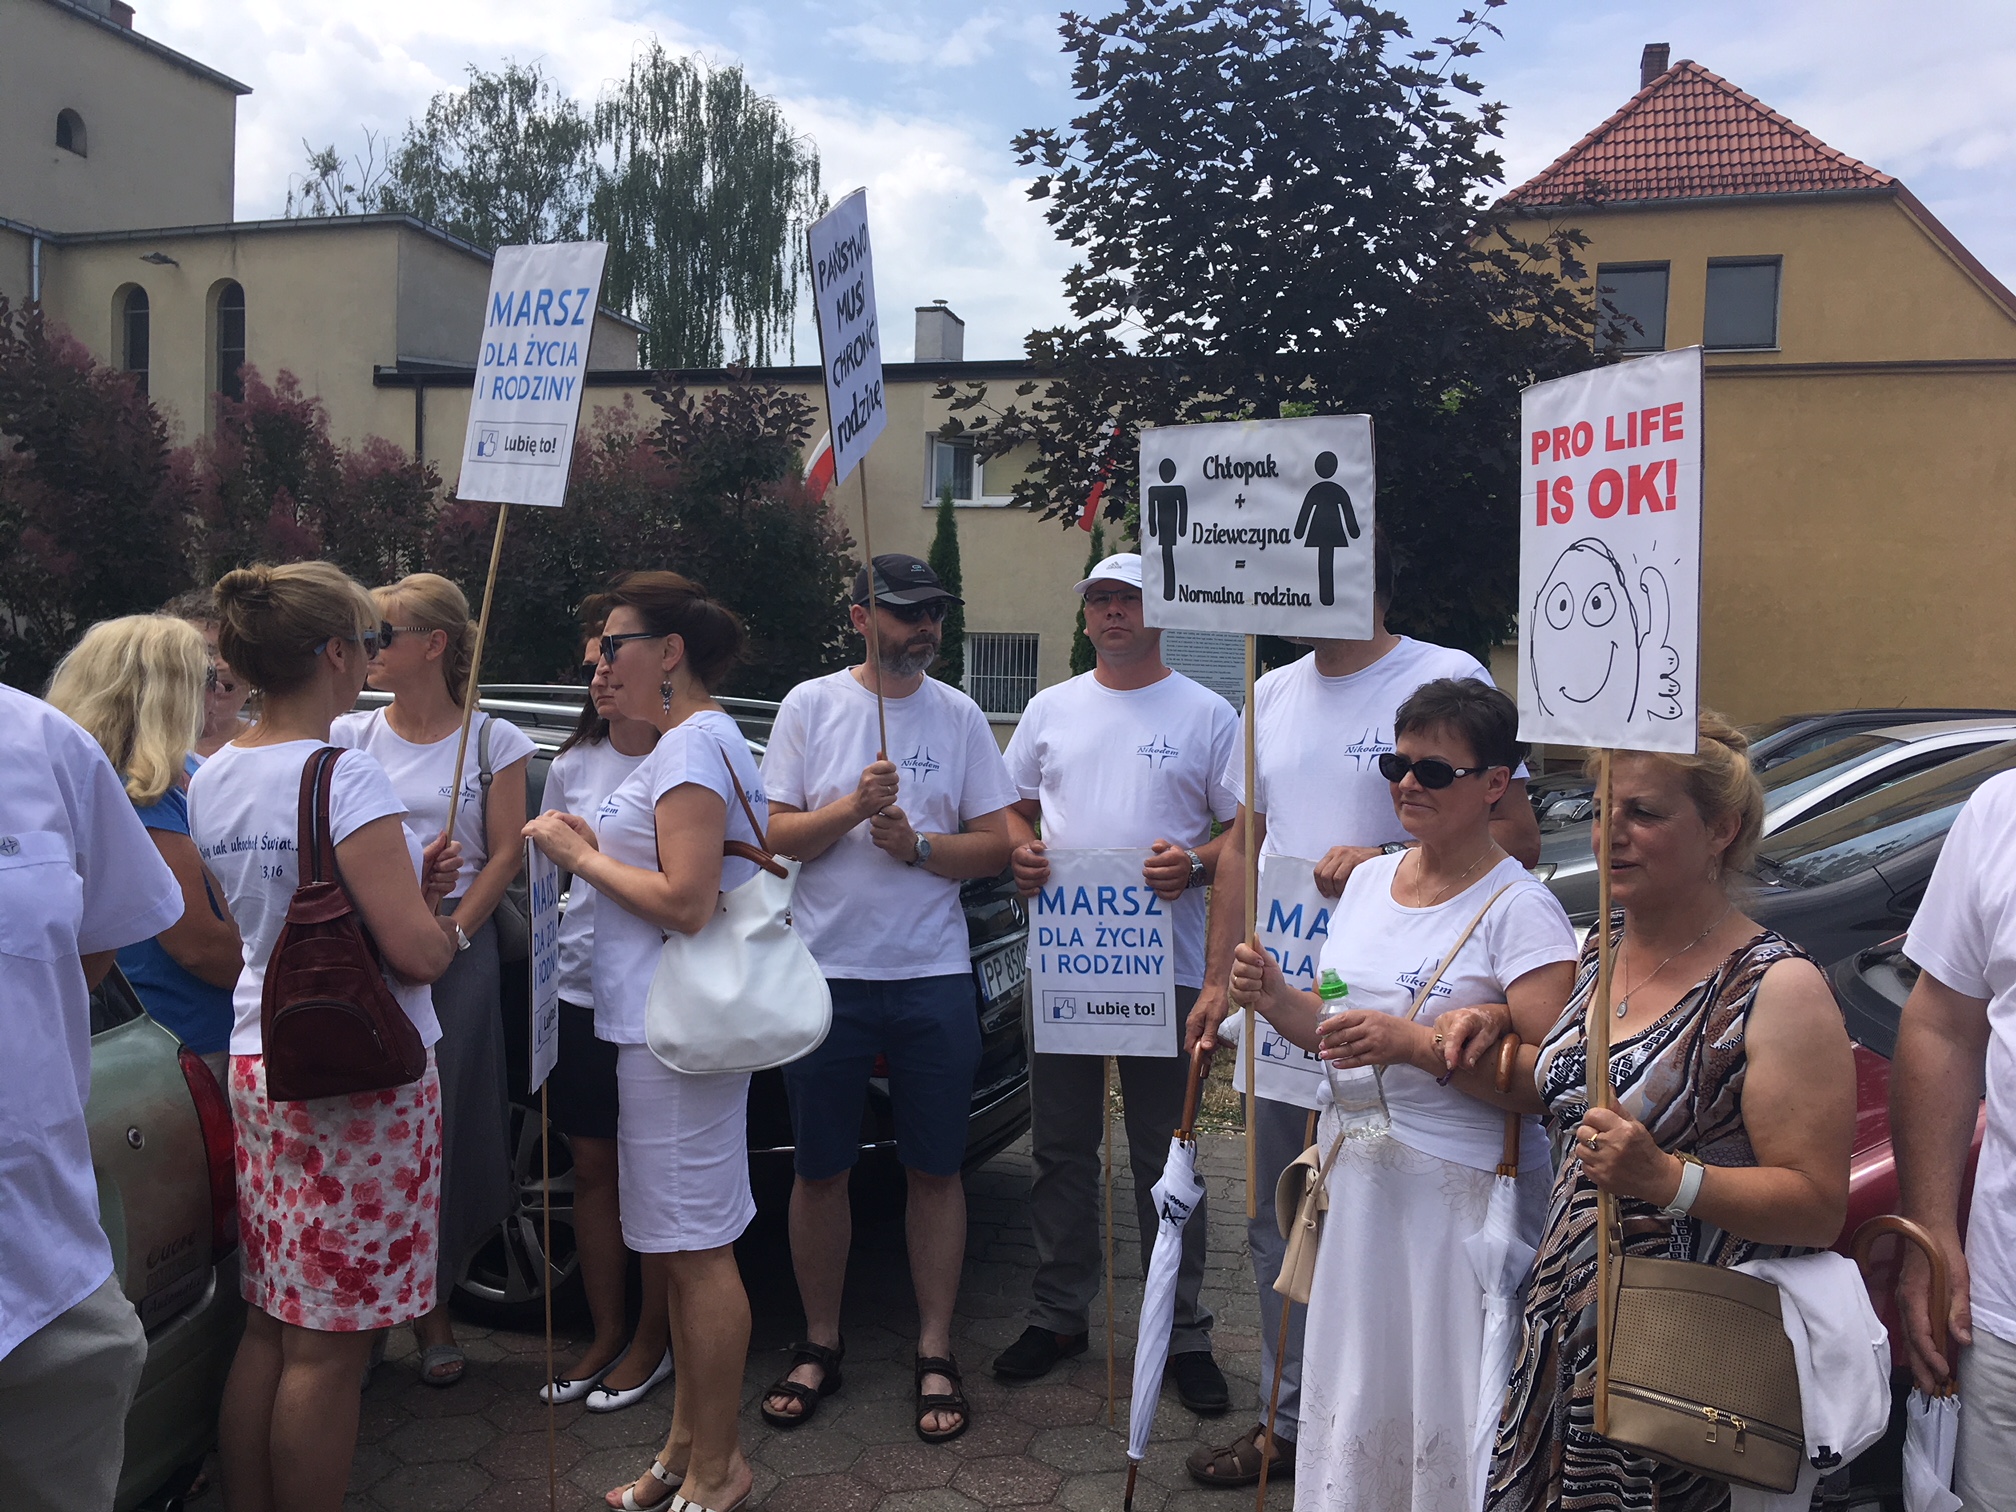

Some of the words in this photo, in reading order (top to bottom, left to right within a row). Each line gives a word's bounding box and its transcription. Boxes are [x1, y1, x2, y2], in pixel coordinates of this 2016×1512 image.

[490, 288, 590, 327] MARSZ
[484, 342, 517, 367] DLA
[524, 334, 578, 367] ŻYCIA
[479, 376, 485, 400] I
[492, 376, 576, 401] RODZINY
[504, 435, 537, 457] Lubię
[540, 437, 557, 454] to!
[1532, 421, 1594, 466] PRO
[1605, 402, 1684, 452] LIFE
[1536, 475, 1574, 527] IS
[1588, 458, 1677, 519] OK!
[1192, 522, 1292, 551] Dziewczyna
[1179, 584, 1245, 604] Normalna
[1254, 585, 1312, 607] rodzina
[1136, 747, 1179, 756] Nikodem
[1344, 745, 1393, 754] Nikodem
[901, 760, 940, 770] Nikodem
[213, 840, 227, 856] tak
[1037, 886, 1162, 916] MARSZ
[1266, 899, 1330, 940] MA
[1039, 927, 1084, 947] DLA
[1095, 921, 1164, 948] ŻYCIA
[1041, 953, 1046, 974] I
[1058, 953, 1165, 975] RODZINY
[984, 957, 1002, 997] PP
[1396, 974, 1452, 994] Nikoem
[1087, 1001, 1130, 1018] Lubię
[1134, 1002, 1156, 1016] to!
